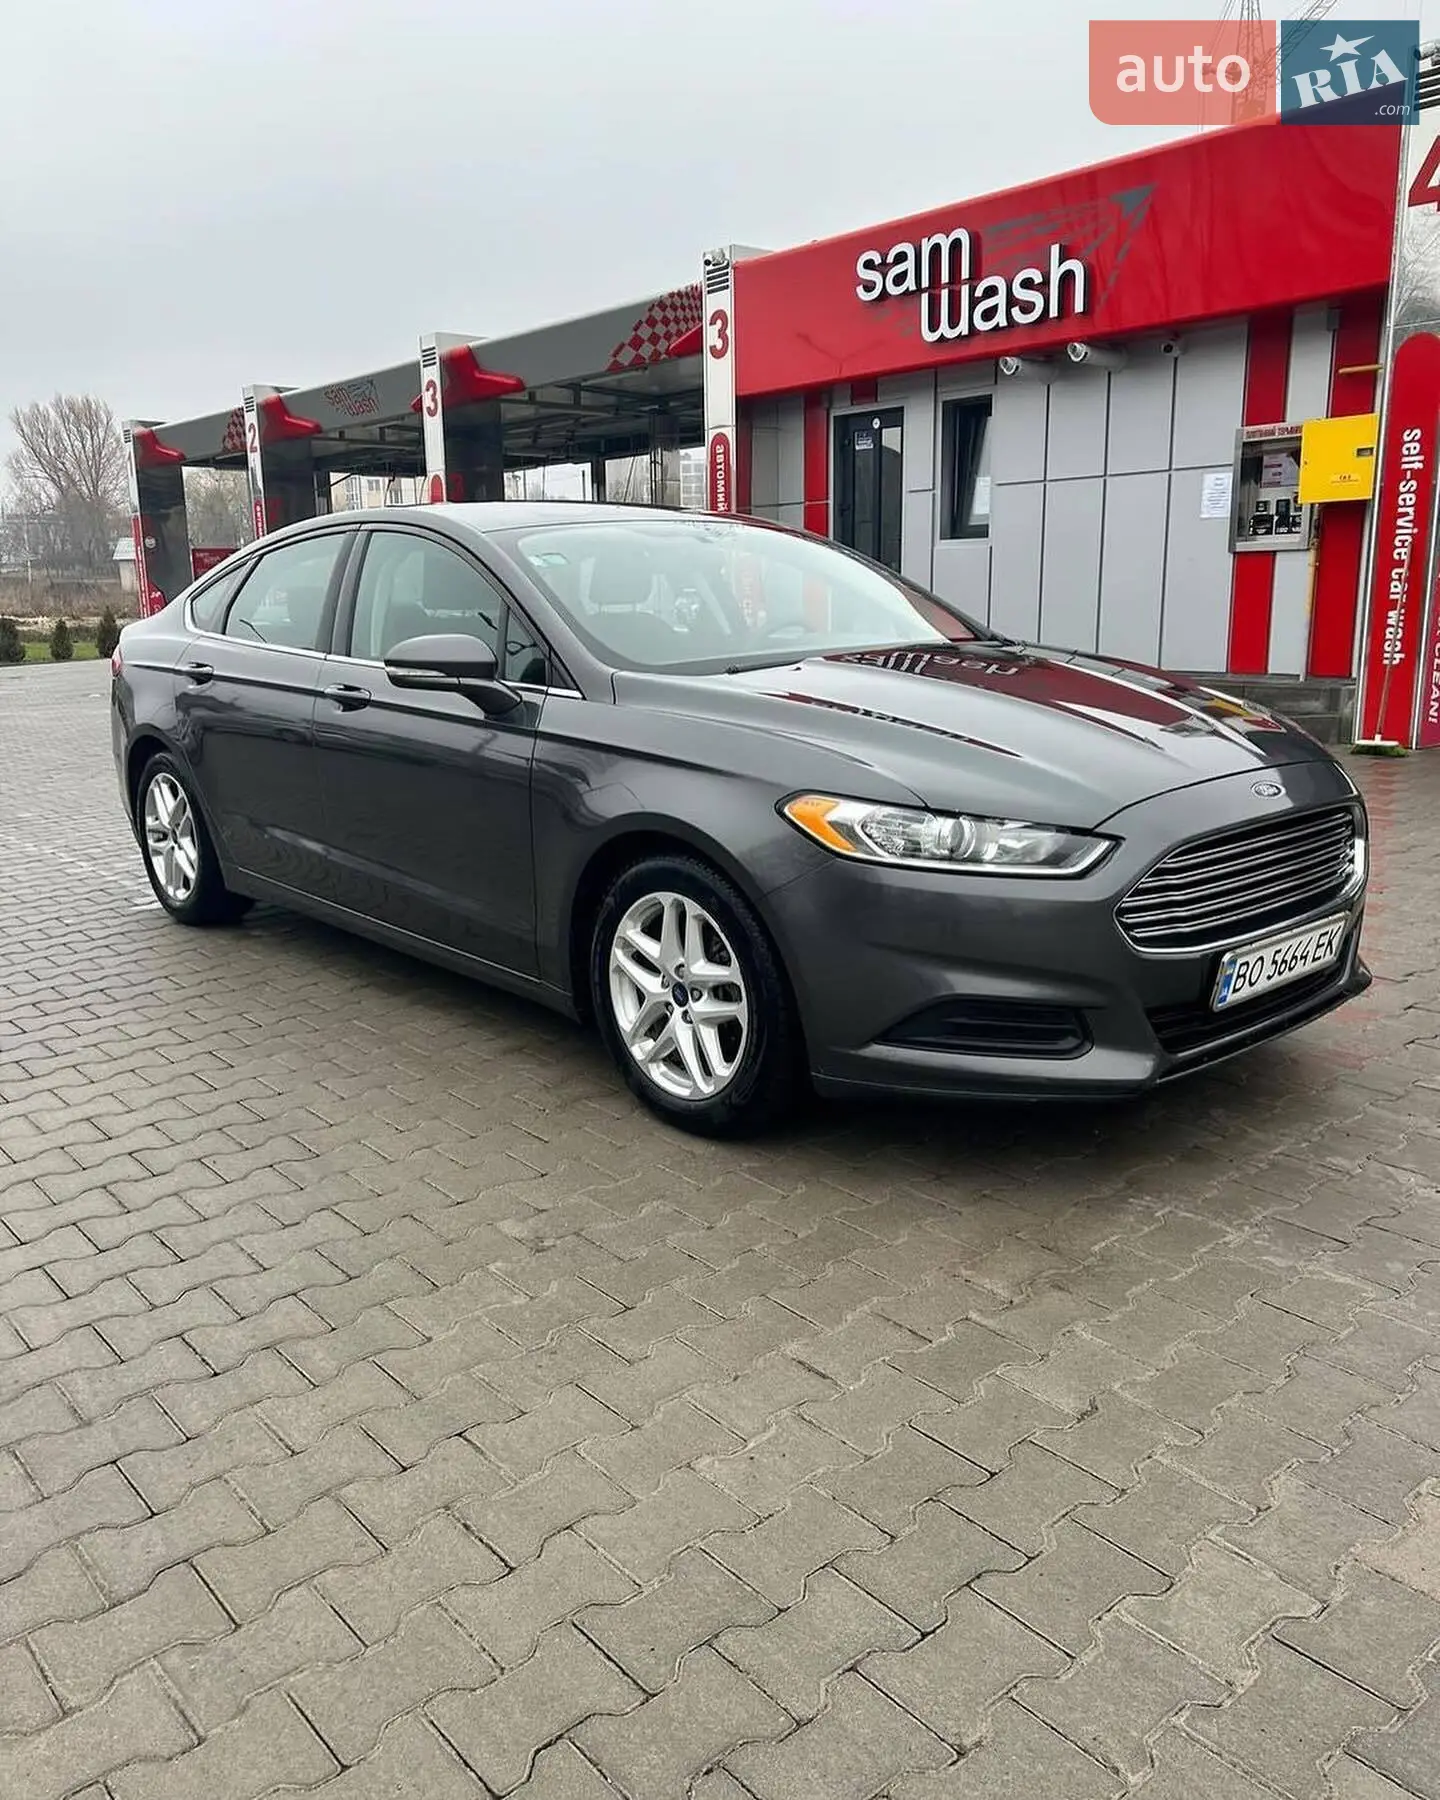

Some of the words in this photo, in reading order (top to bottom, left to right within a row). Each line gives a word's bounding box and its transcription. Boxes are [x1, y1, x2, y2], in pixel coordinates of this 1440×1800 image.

[1408, 135, 1440, 213] 4
[856, 227, 971, 301] sam
[920, 243, 1085, 343] wash
[708, 308, 729, 360] 3
[421, 379, 438, 417] 3
[247, 422, 258, 453] 2
[1393, 428, 1425, 561] self-service
[1382, 609, 1406, 666] wash
[1231, 955, 1265, 994] BO
[1265, 937, 1314, 981] 5664
[1311, 924, 1342, 963] EK
